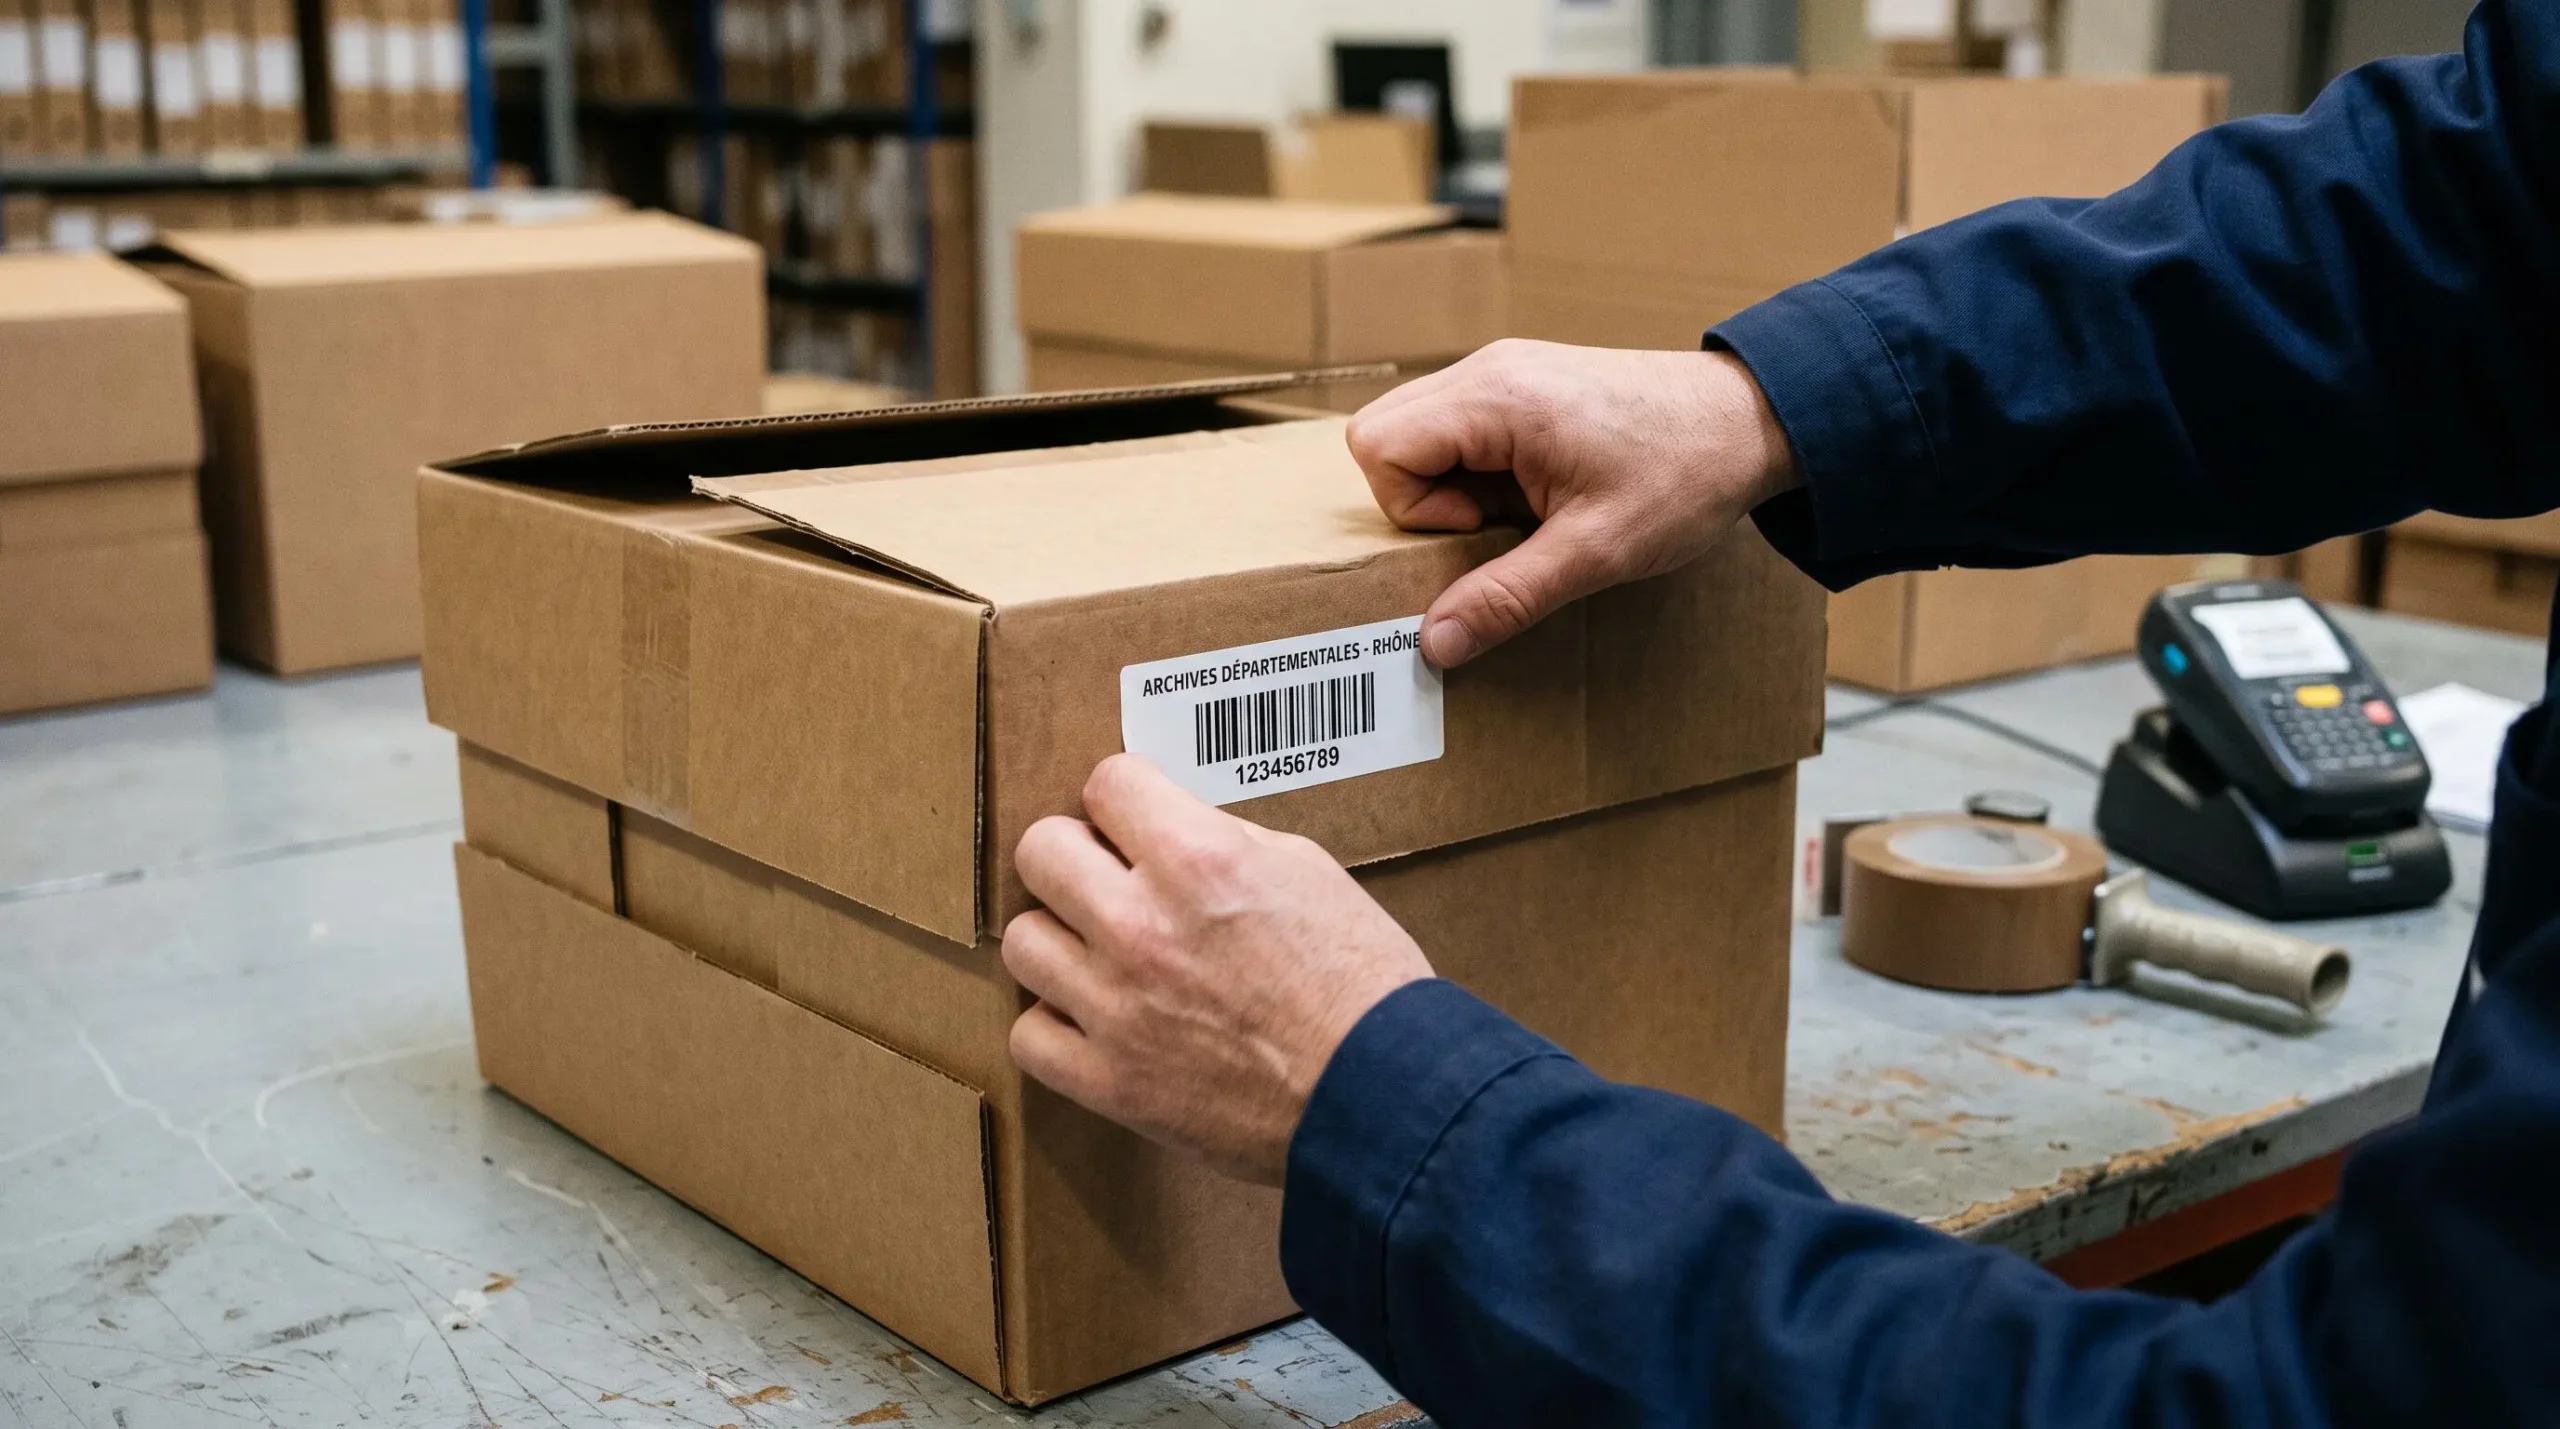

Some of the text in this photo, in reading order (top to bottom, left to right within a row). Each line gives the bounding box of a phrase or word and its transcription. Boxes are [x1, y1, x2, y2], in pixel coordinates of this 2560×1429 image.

[1142, 667, 1218, 697] ARCHIVES
[1222, 642, 1360, 683] DÉPARTEMENTALES
[1372, 630, 1420, 656] RHÔNE
[1235, 746, 1340, 785] 123456789
